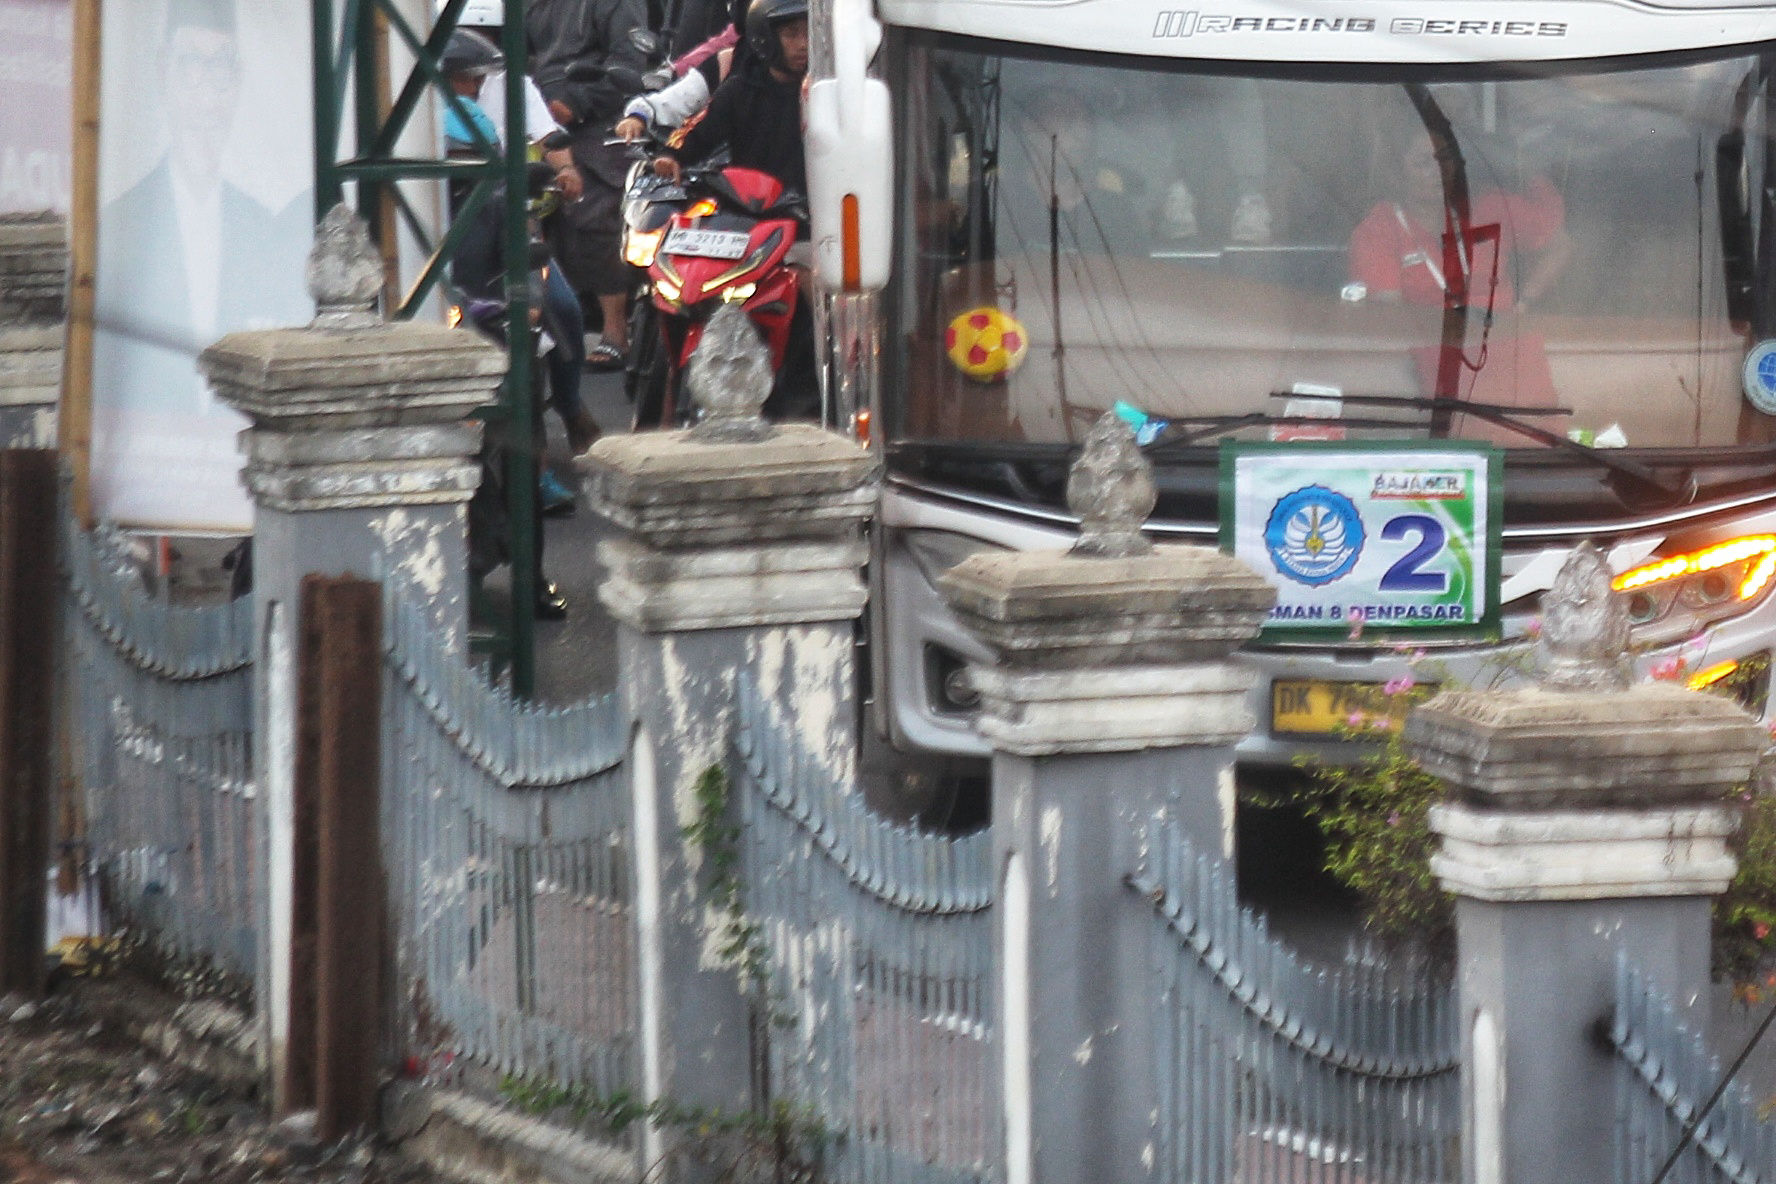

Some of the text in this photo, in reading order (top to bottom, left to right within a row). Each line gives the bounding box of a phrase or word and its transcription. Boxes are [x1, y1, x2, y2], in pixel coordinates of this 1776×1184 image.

[1388, 17, 1569, 37] SERIES
[1378, 514, 1447, 593] 2
[1330, 605, 1343, 620] 8
[1349, 605, 1464, 620] DENPASAR
[1279, 686, 1312, 715] DK
